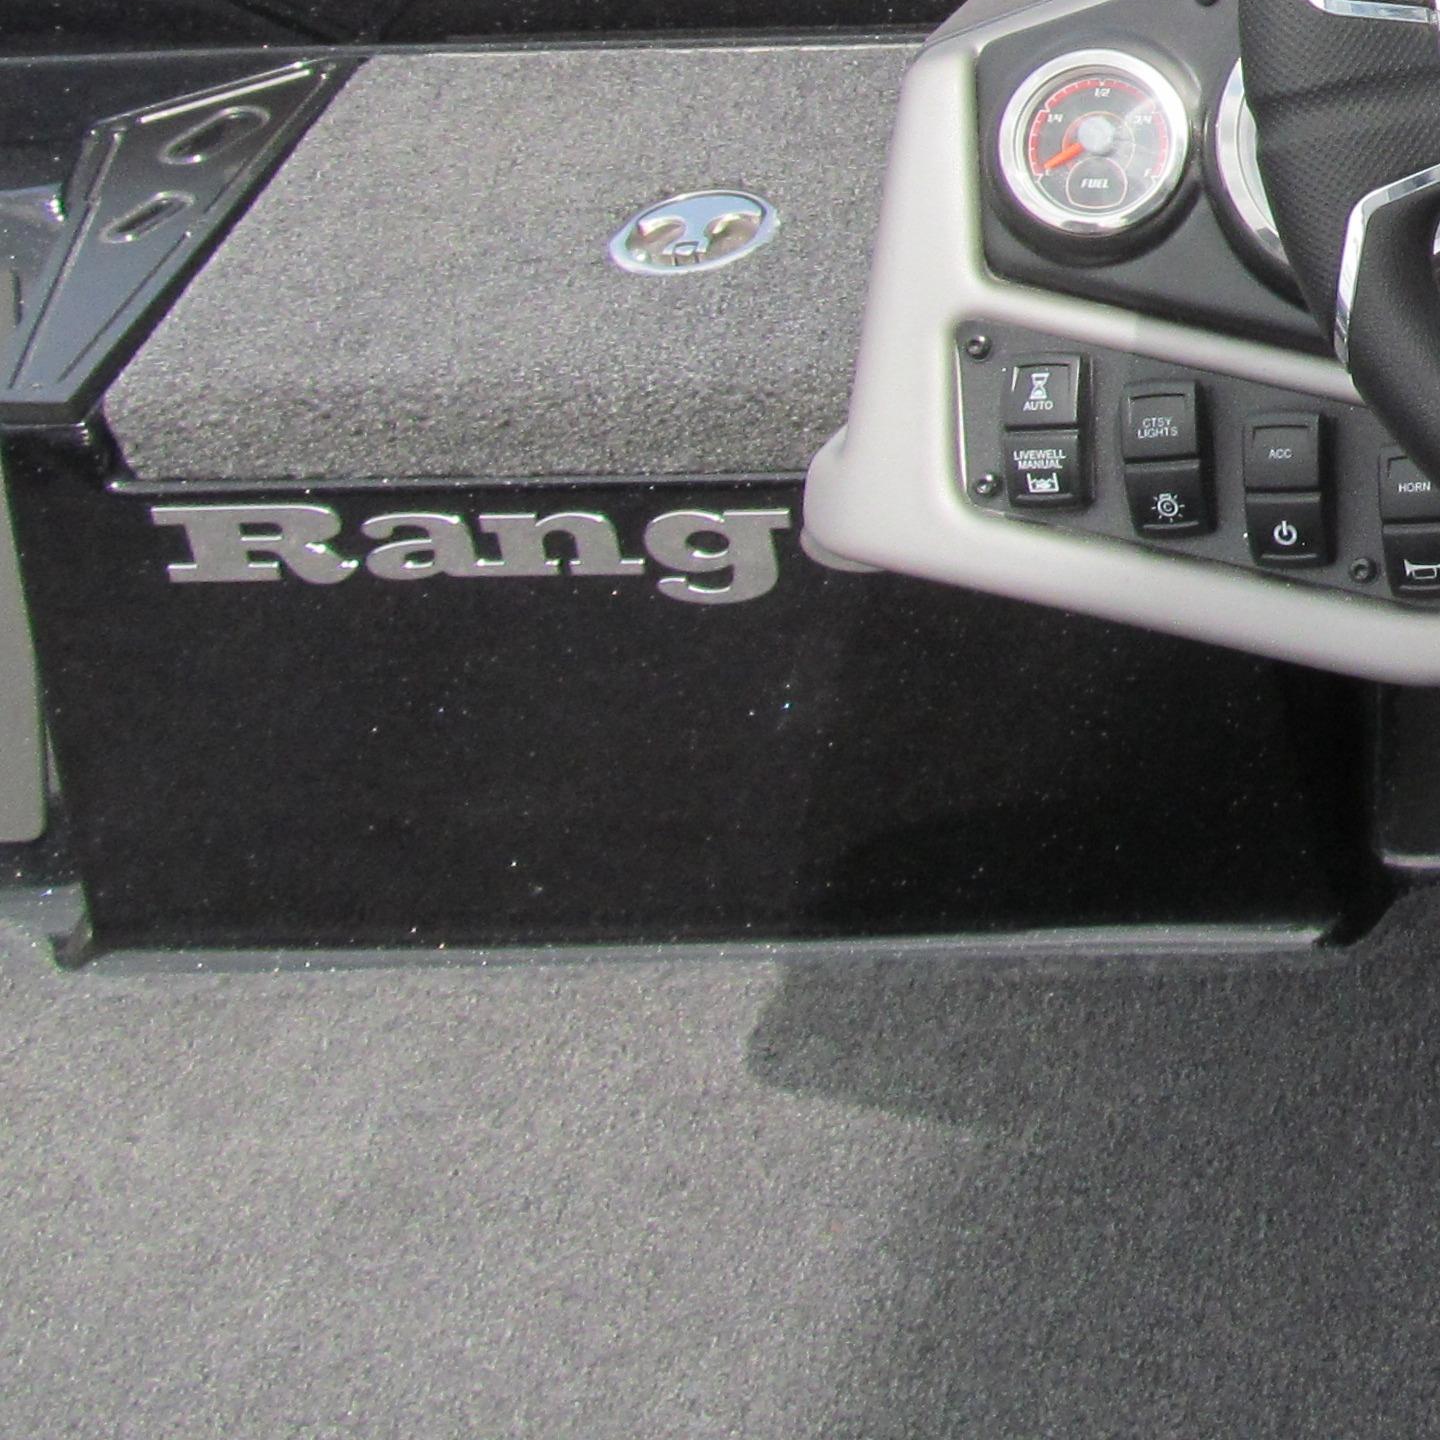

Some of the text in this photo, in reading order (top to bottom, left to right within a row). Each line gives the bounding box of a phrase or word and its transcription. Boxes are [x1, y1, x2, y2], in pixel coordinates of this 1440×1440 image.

[1081, 178, 1109, 189] FUEL
[1023, 401, 1053, 411] AUTO
[1142, 417, 1173, 428] CTSY
[1138, 427, 1178, 439] LIGHTS
[1013, 449, 1066, 461] LIVEWELL
[1268, 449, 1292, 459] ACC
[1018, 460, 1062, 470] MANUAL
[1399, 481, 1431, 492] HORN
[151, 503, 895, 604] Rang
